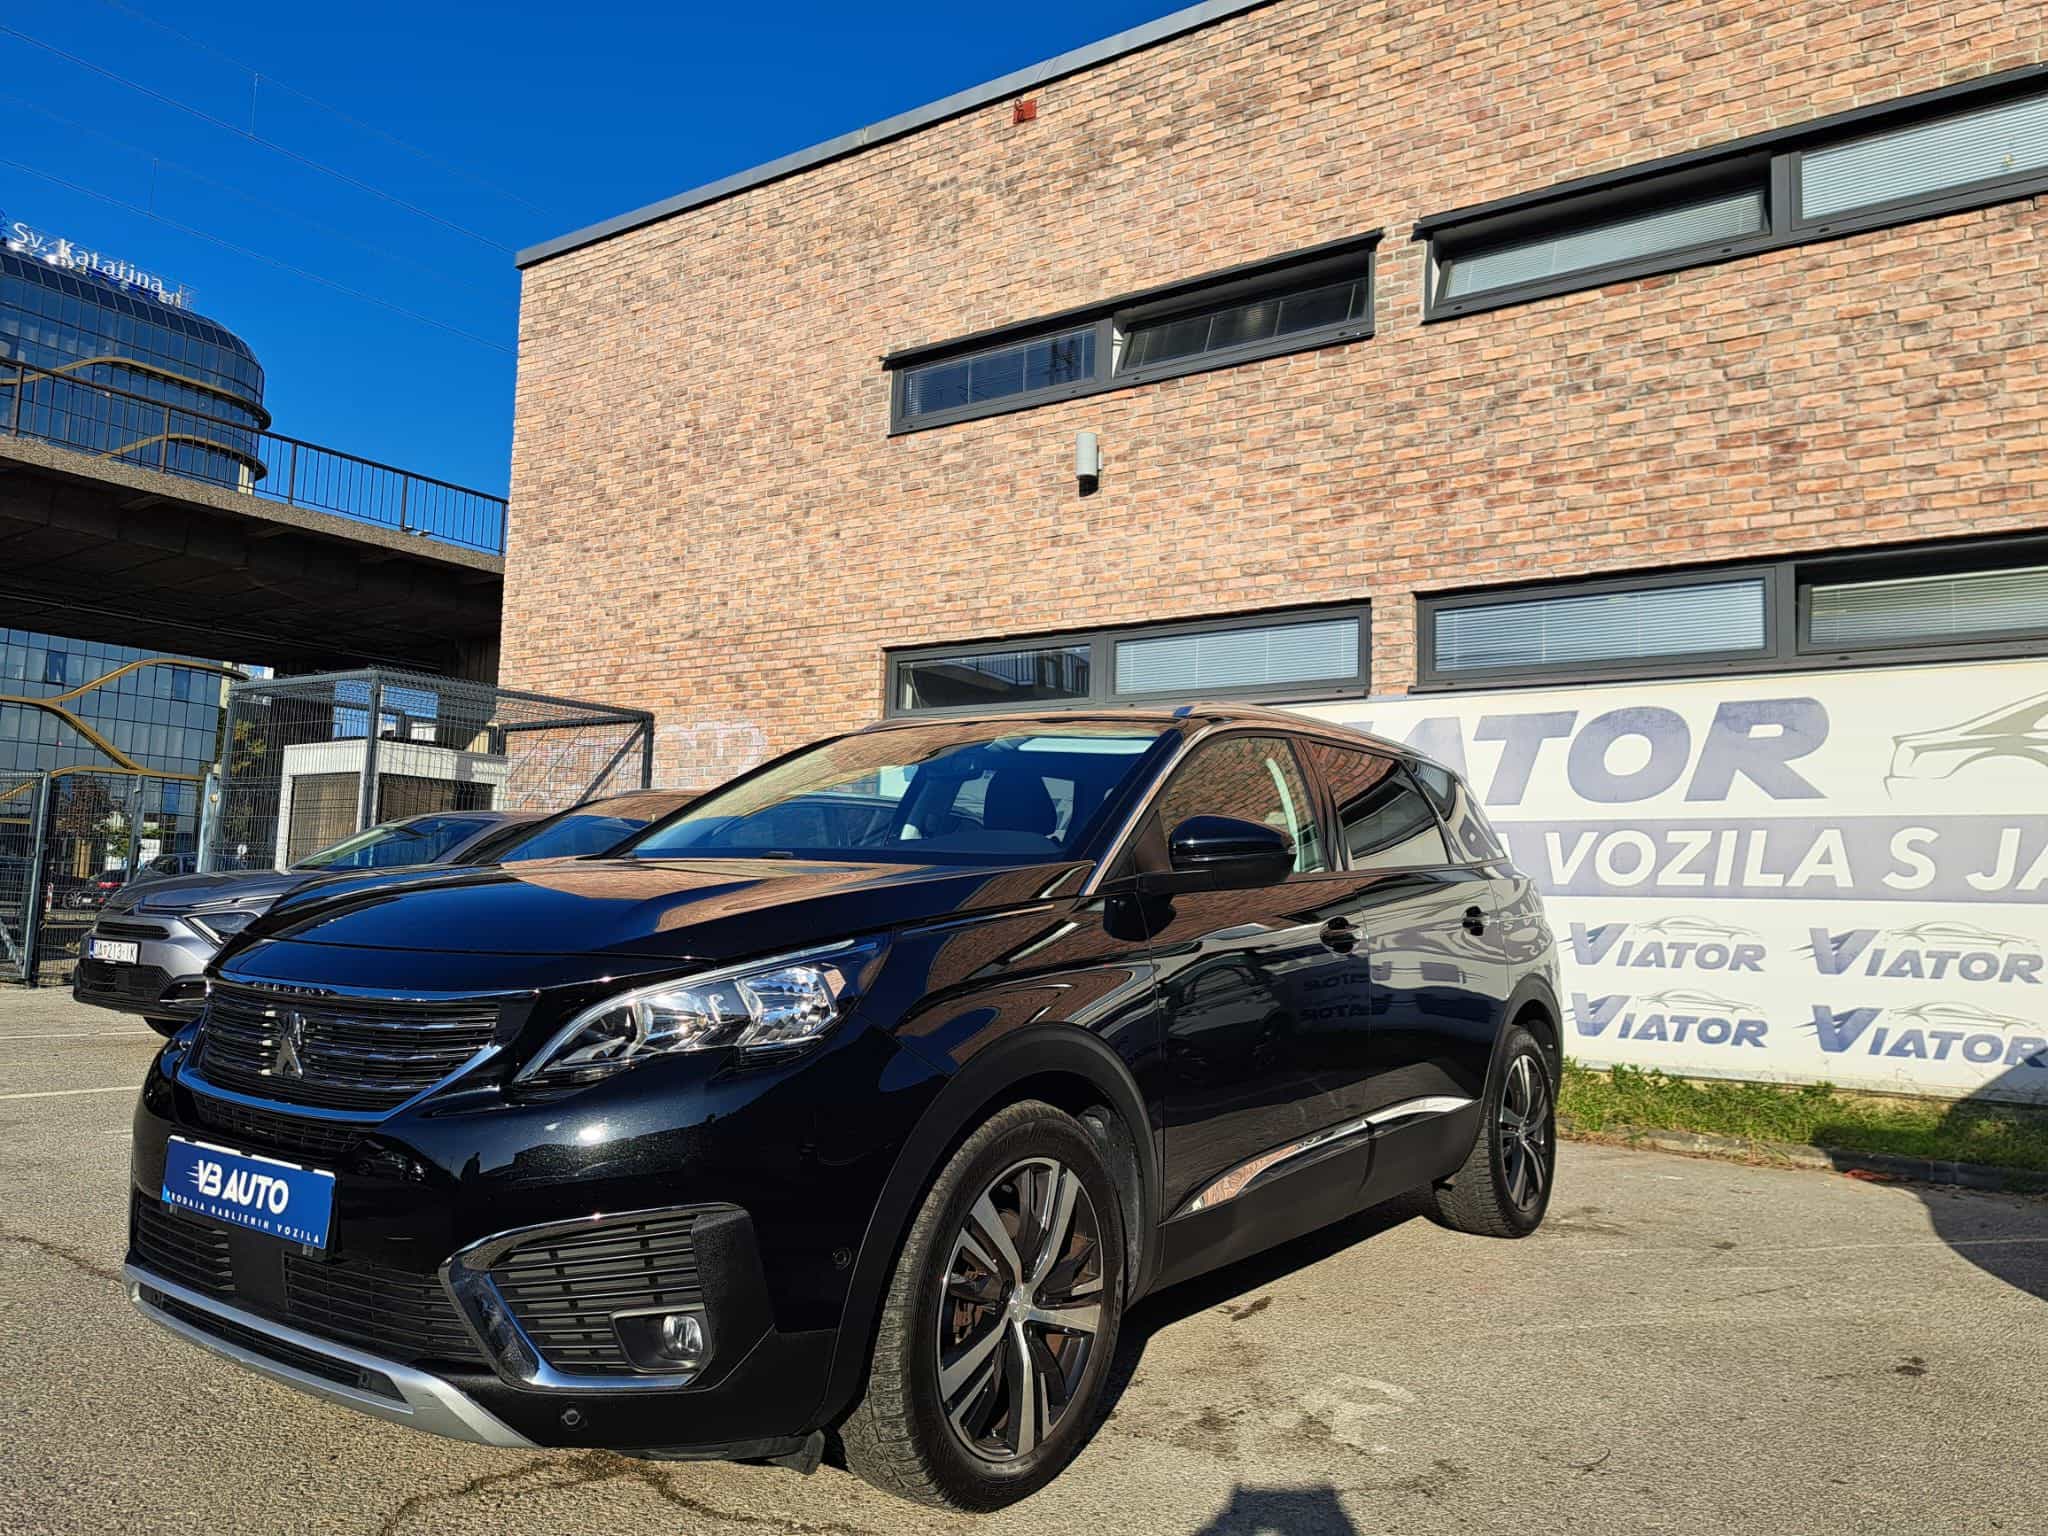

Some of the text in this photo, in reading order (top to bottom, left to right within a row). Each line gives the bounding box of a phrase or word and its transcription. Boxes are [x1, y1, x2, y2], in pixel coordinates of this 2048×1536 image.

[1342, 696, 1830, 806] ATOR
[1544, 828, 1854, 889] VOZILA
[1882, 826, 1940, 890] S
[1569, 921, 1768, 973] VIATOR
[1809, 927, 2045, 985] VIATOR
[1571, 992, 1770, 1049] VIATOR
[1811, 1003, 2048, 1068] VIATOR
[221, 1168, 289, 1215] AUTO
[276, 1223, 319, 1244] VOZILA
